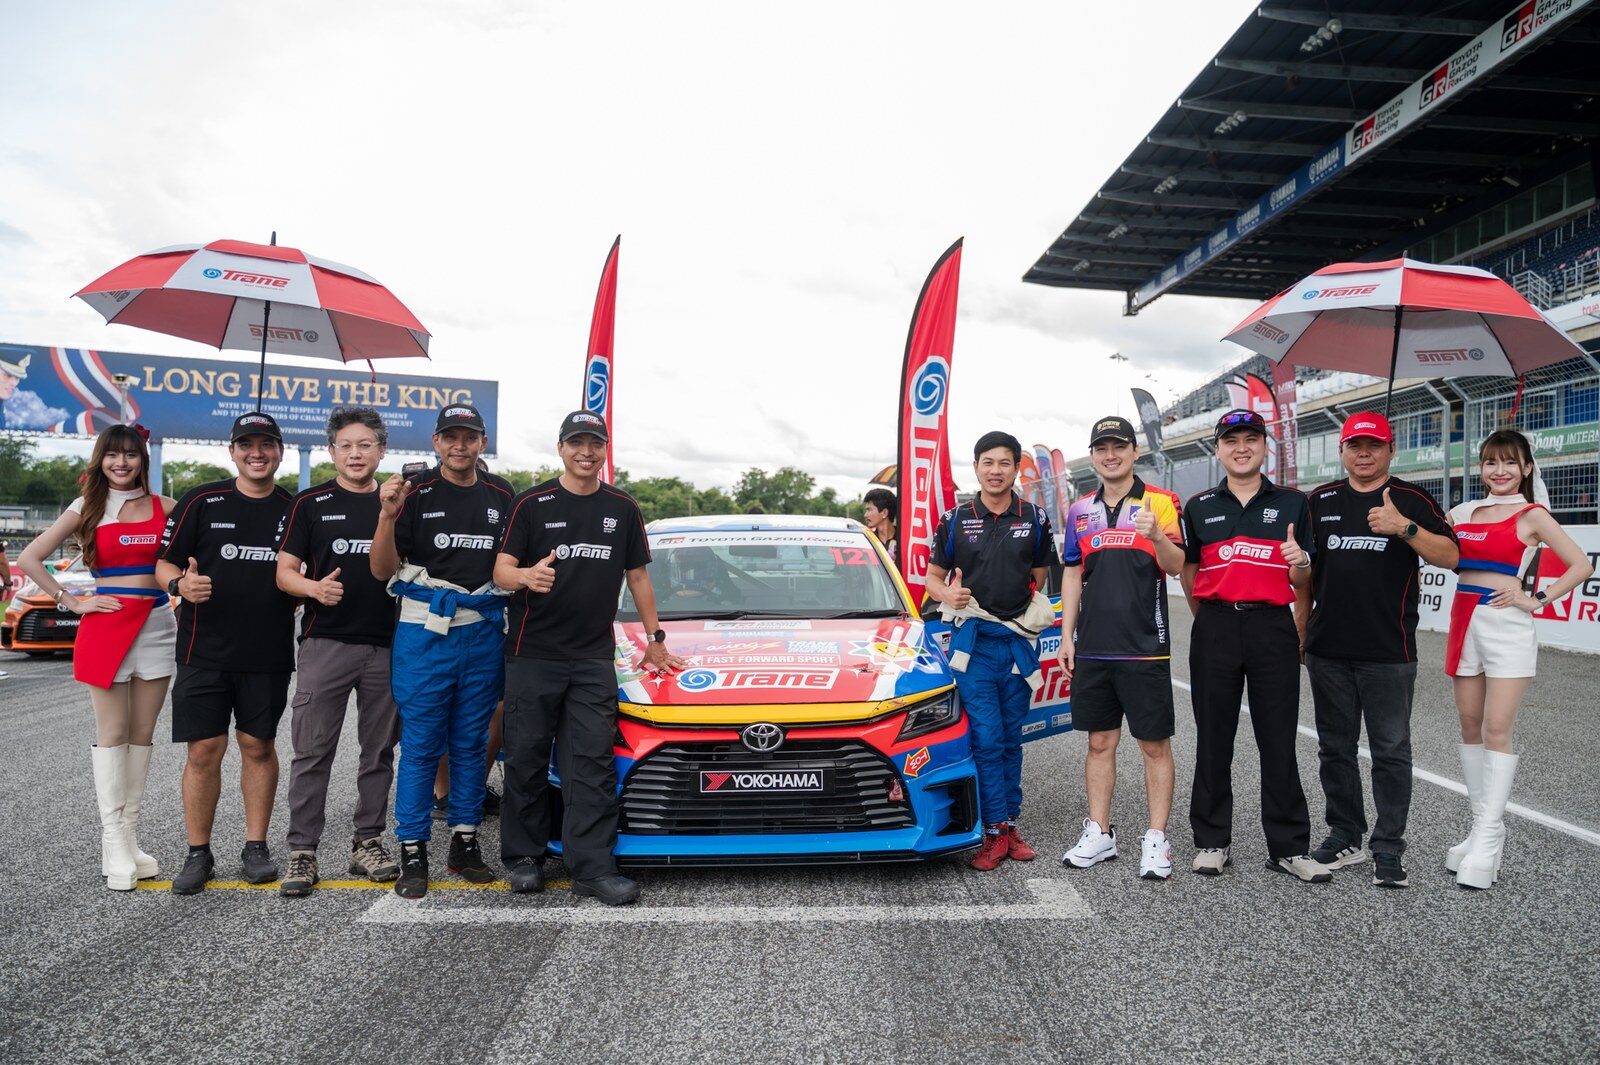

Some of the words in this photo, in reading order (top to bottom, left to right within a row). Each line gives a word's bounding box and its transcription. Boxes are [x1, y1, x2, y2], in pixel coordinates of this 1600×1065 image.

[1536, 0, 1572, 28] Racing
[1502, 13, 1534, 50] GR
[1450, 41, 1483, 68] TOYOTA
[1449, 54, 1479, 79] GAZOO
[1447, 65, 1477, 91] Racing
[1420, 77, 1447, 107] GR
[1377, 99, 1403, 121] TOYOTA
[1375, 110, 1400, 130] GAZOO
[1374, 120, 1398, 140] Racing
[1352, 129, 1373, 153] GR
[223, 269, 291, 288] Trane
[1317, 284, 1381, 299] Trane
[1582, 304, 1600, 315] true
[142, 366, 242, 397] LONG
[249, 374, 321, 403] LIVE
[327, 378, 391, 407] THE
[397, 384, 473, 410] KING
[218, 401, 240, 409] WITH
[290, 406, 321, 414] RESPECT
[910, 426, 942, 577] Trane
[1204, 515, 1226, 524] TITANIUM
[128, 535, 156, 543] Trane
[451, 534, 495, 549] Trane
[807, 536, 855, 544] Racing
[1012, 530, 1030, 538] 90
[349, 539, 373, 554] Tra
[570, 543, 612, 560] Trane
[1341, 536, 1389, 552] Trane
[238, 545, 279, 561] Tran
[828, 547, 879, 566] 121
[1042, 640, 1060, 653] PEP
[739, 655, 795, 663] FORWARD
[798, 655, 835, 663] SPORT
[718, 669, 833, 687] Trane
[732, 773, 820, 788] YOKOHAMA
